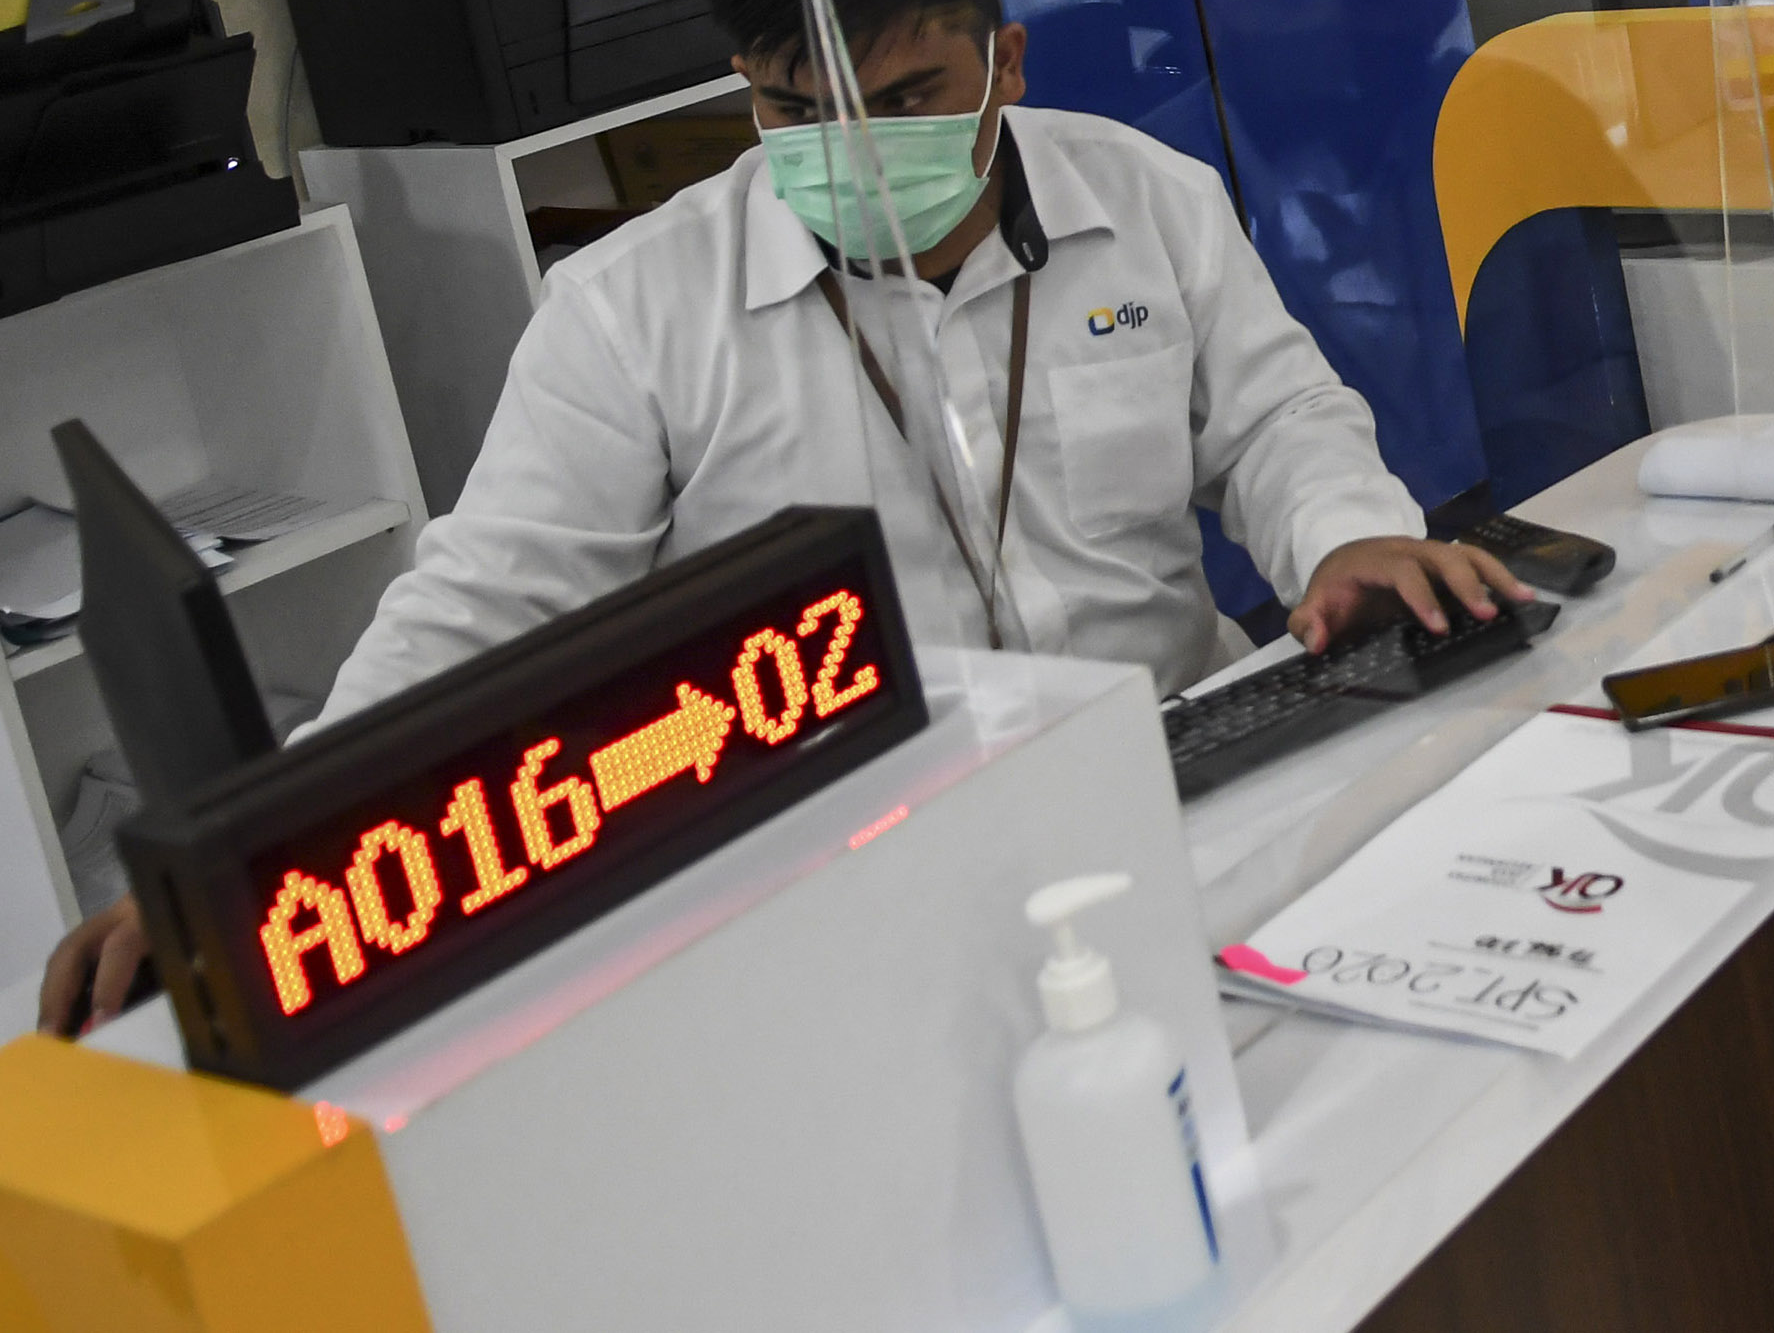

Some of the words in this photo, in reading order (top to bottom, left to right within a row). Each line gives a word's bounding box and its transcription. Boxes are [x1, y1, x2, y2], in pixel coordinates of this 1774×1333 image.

[1115, 301, 1149, 330] djp
[259, 738, 602, 1016] A016
[731, 588, 880, 745] 02
[1302, 947, 1465, 996] 2020
